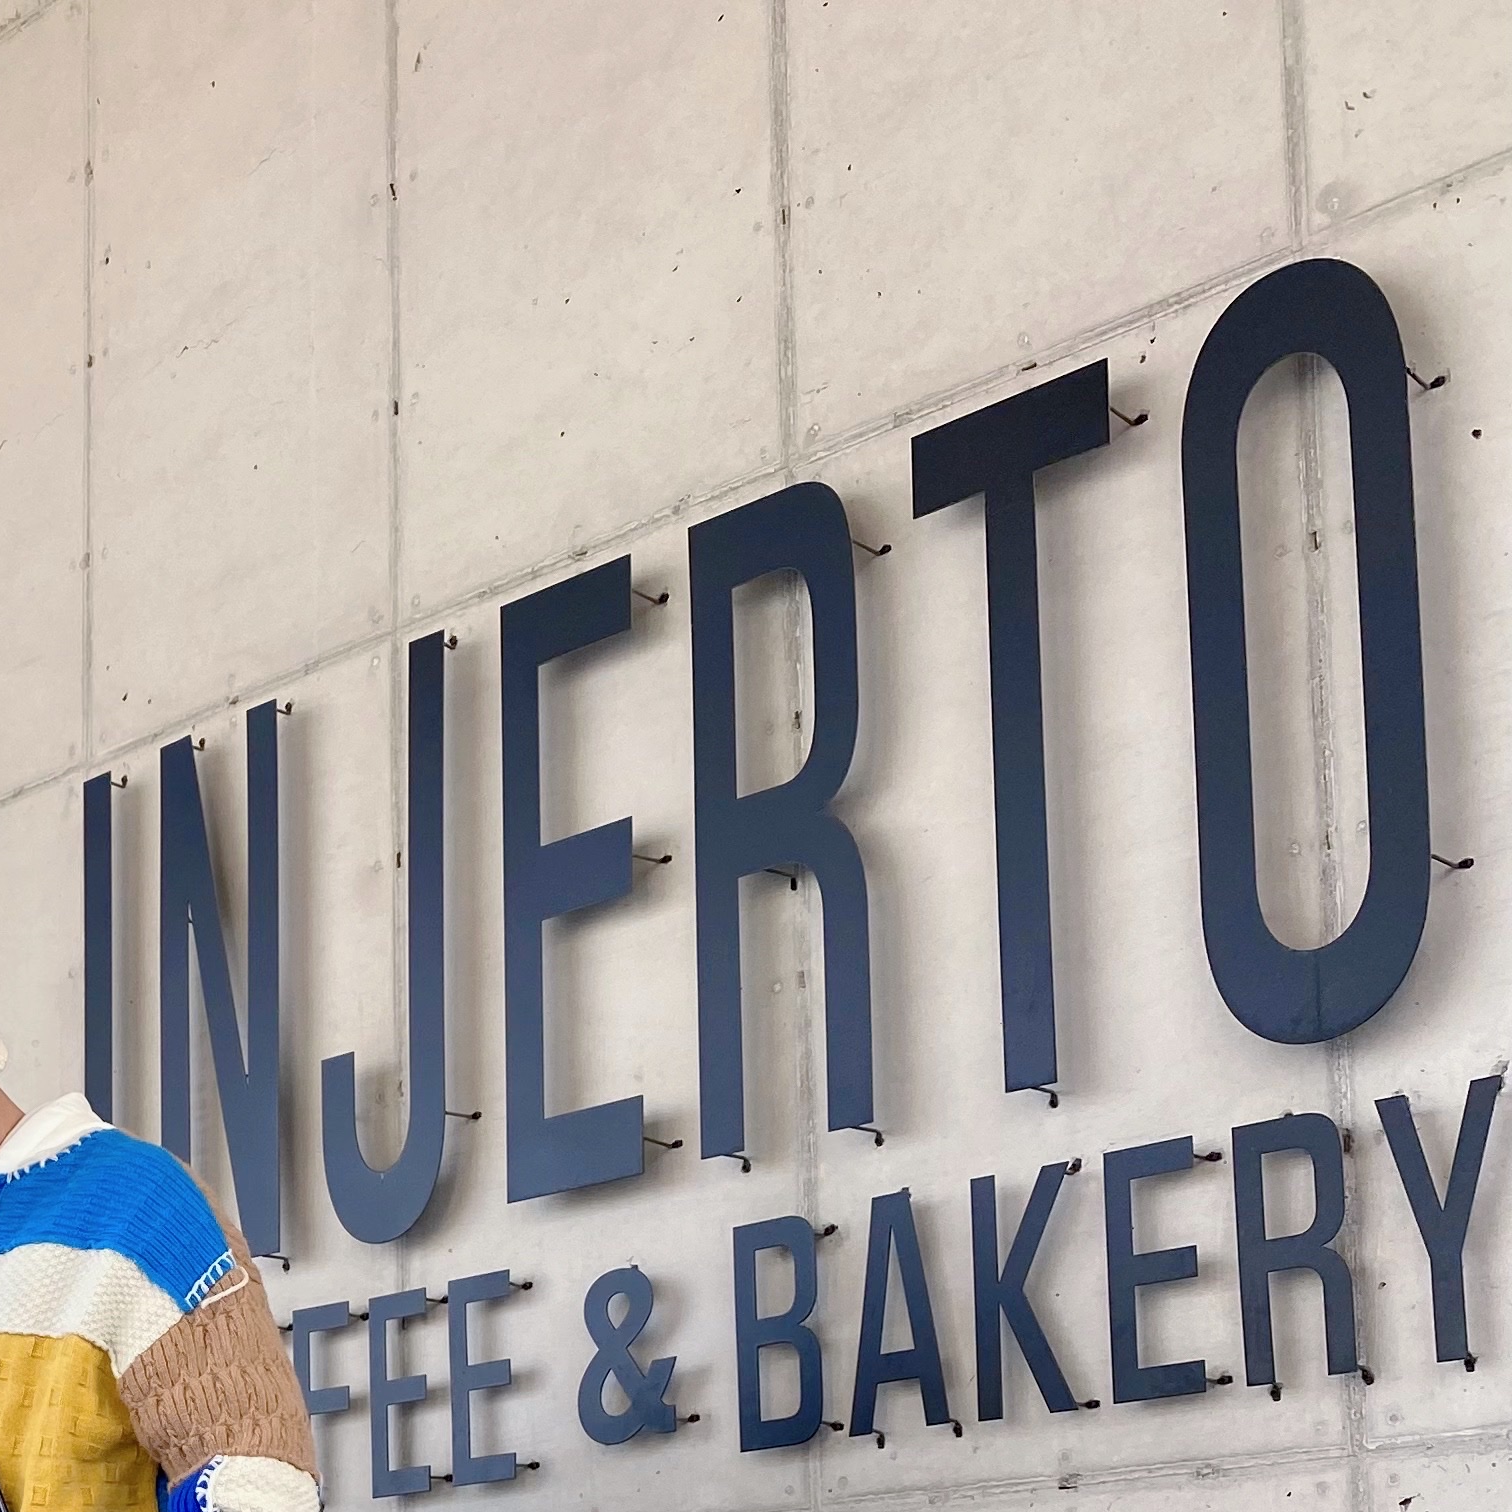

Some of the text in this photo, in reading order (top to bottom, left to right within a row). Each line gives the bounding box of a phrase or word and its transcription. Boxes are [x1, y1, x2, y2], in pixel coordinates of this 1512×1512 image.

[83, 257, 1431, 1255] INJERTO
[292, 1074, 1507, 1499] FEE & BAKERY
